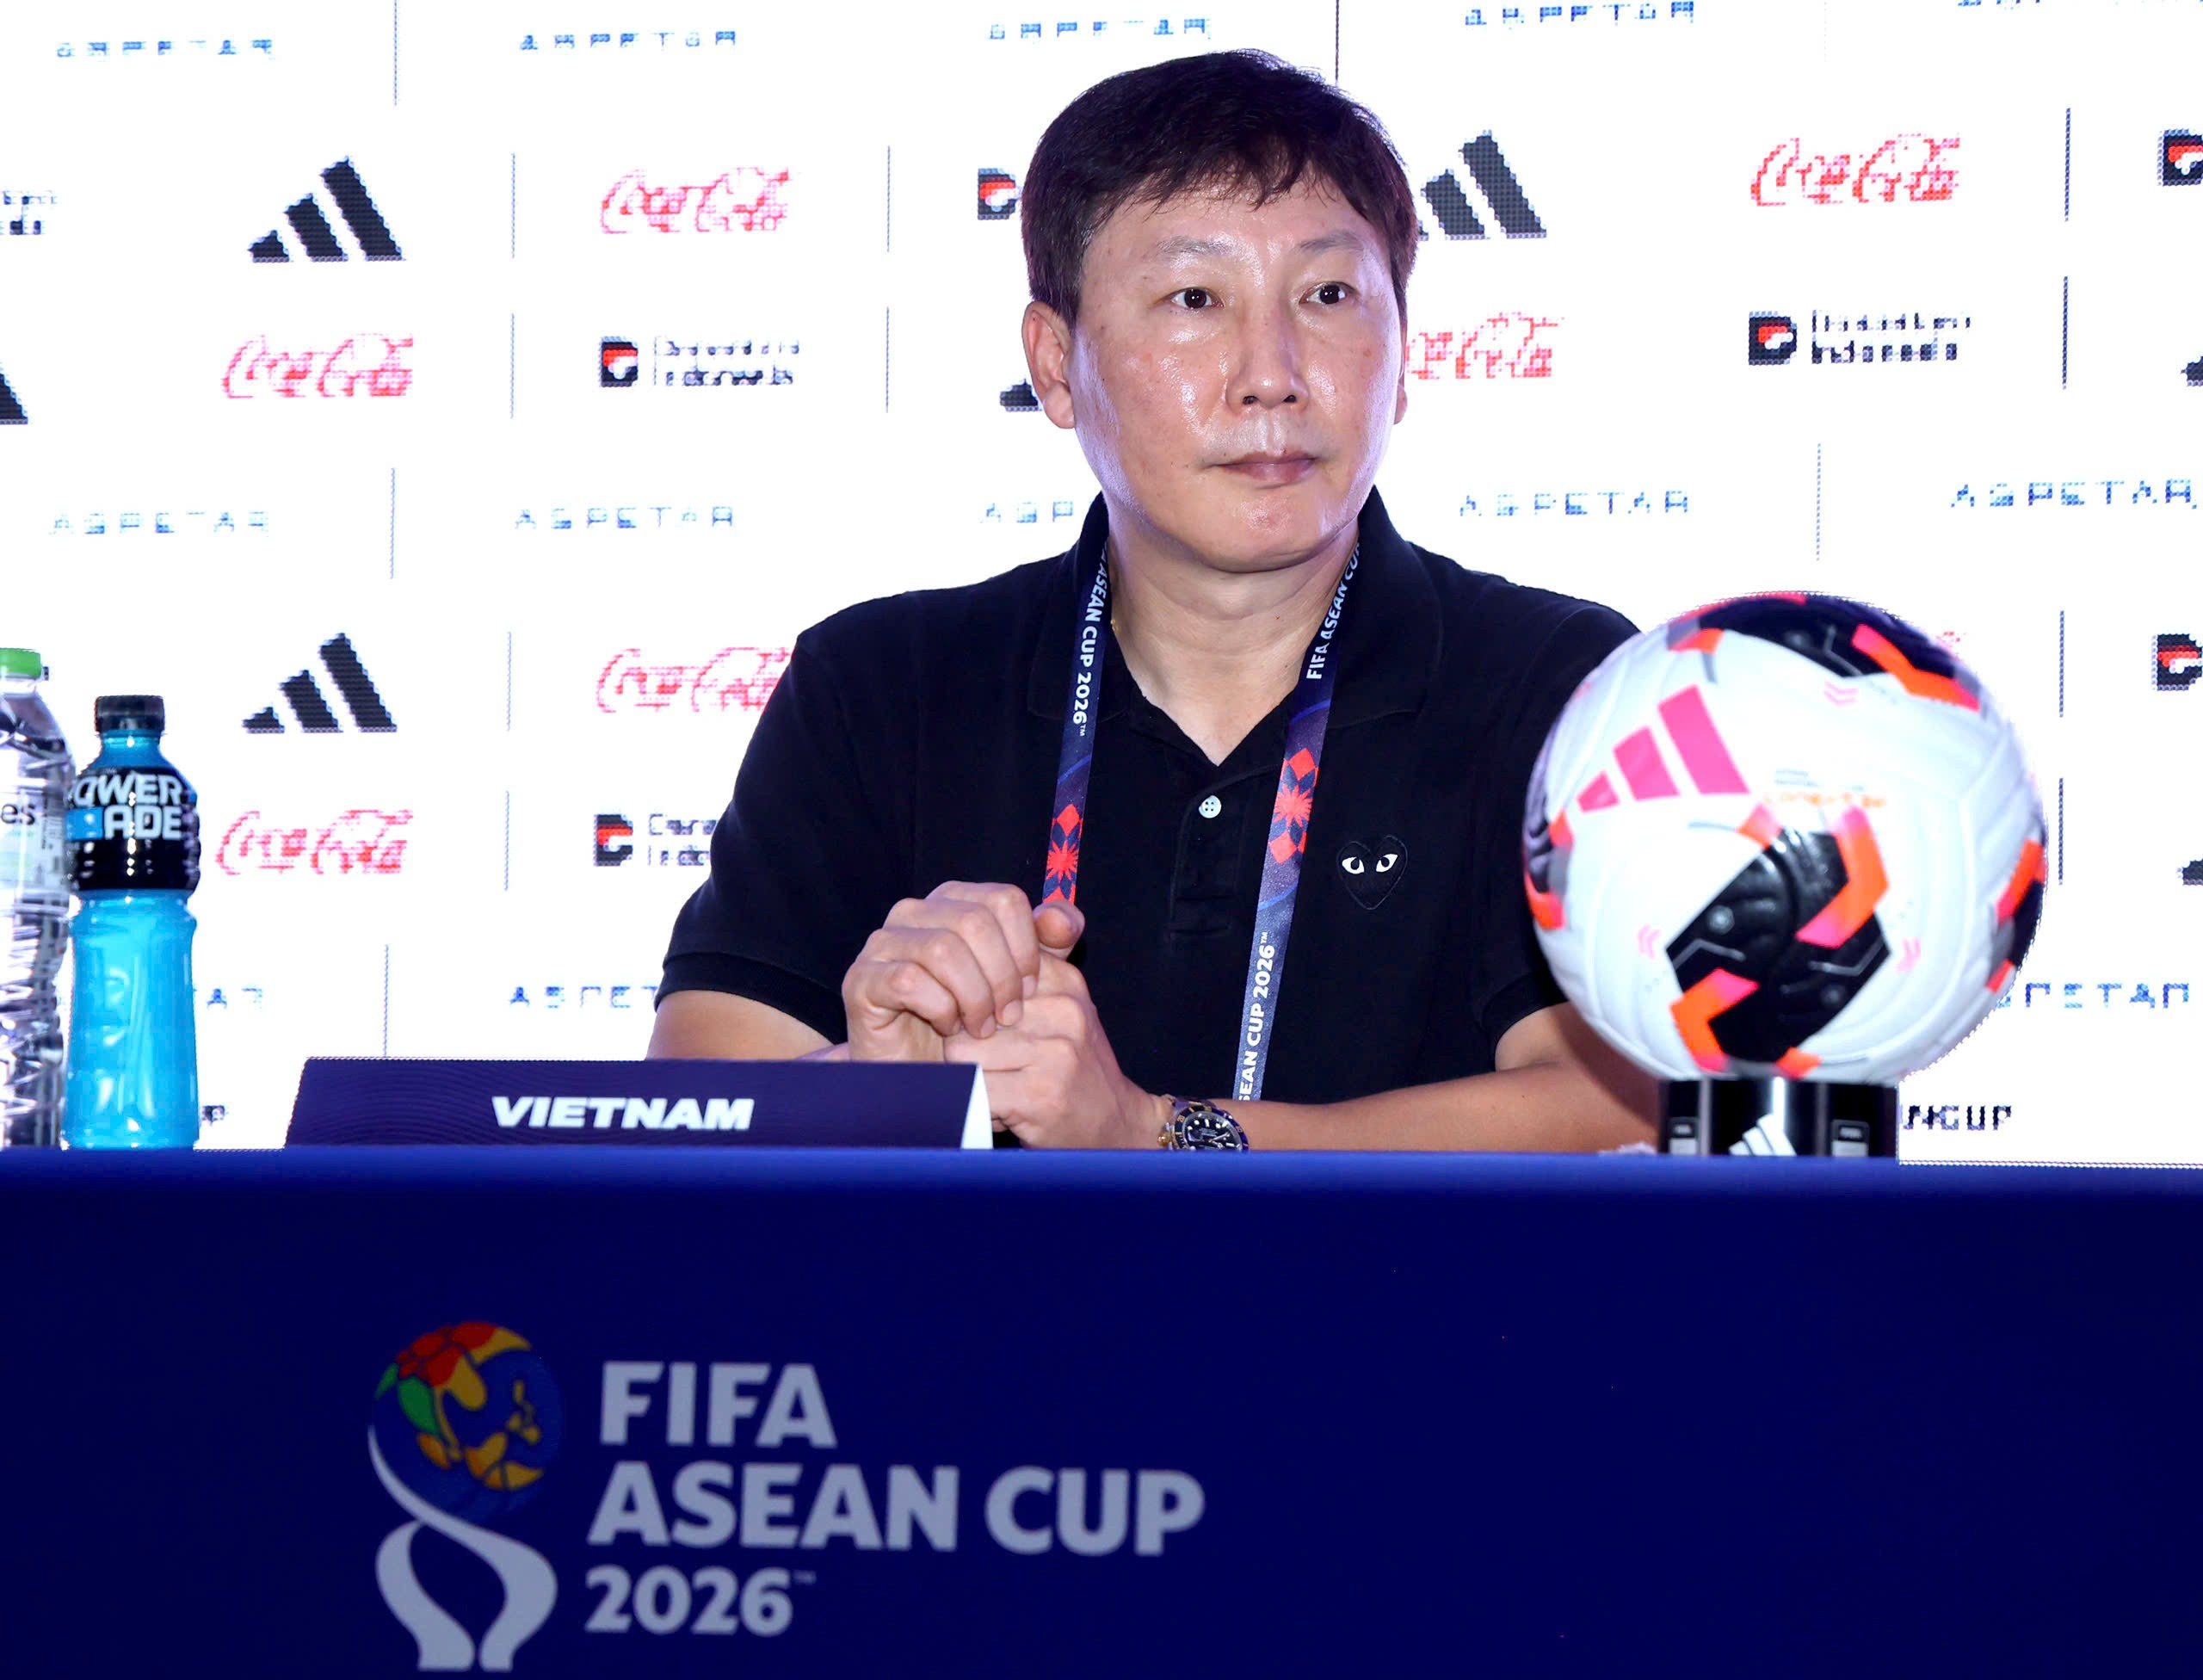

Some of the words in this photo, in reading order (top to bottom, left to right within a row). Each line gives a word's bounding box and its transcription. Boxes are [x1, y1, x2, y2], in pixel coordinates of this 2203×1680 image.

[1084, 562, 1108, 622] ASEAN
[1080, 626, 1098, 667] CUP
[1306, 642, 1330, 680] FIFA
[1320, 580, 1348, 639] ASEAN
[103, 805, 182, 840] ADE
[1247, 1003, 1265, 1047] CUP
[491, 1096, 755, 1130] VIETNAM
[601, 1361, 837, 1448] FIFA
[586, 1461, 960, 1552] ASEAN
[984, 1465, 1206, 1557] CUP
